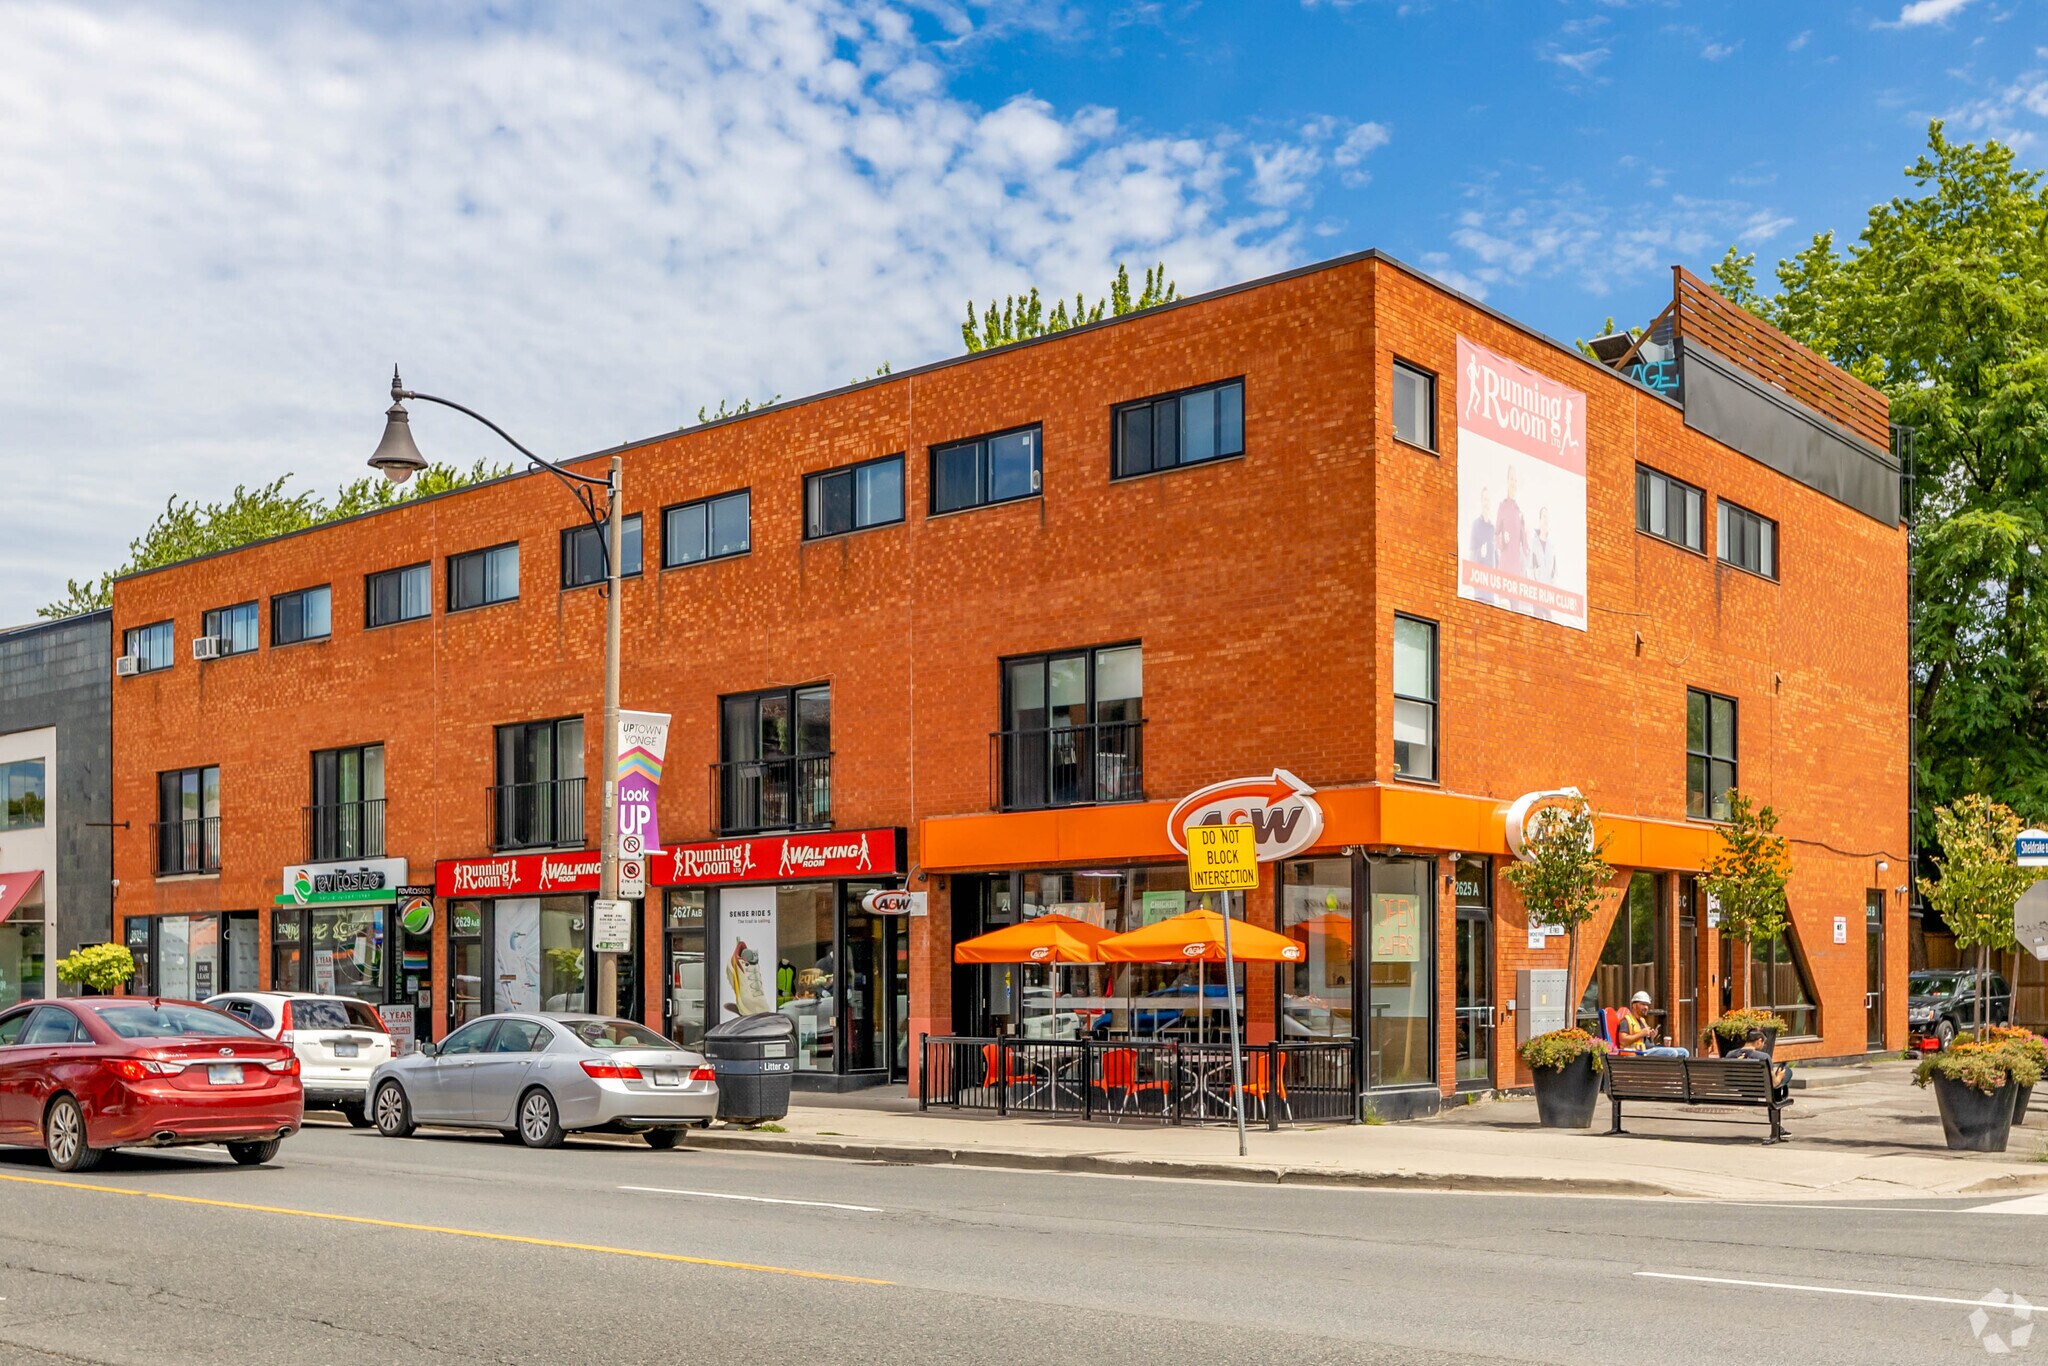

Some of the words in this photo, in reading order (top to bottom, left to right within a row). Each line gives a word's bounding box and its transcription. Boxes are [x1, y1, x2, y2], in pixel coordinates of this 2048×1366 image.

[1482, 364, 1562, 438] Running
[1470, 568, 1489, 586] JOIN
[1490, 574, 1501, 590] US
[1502, 578, 1518, 594] FOR
[1519, 582, 1538, 600] FREE
[1539, 589, 1555, 606] RUN
[1555, 593, 1577, 611] CLUB!
[623, 723, 662, 736] UPTOWN
[625, 735, 657, 747] YONGE
[621, 786, 650, 802] Look
[620, 804, 651, 835] UP
[1202, 830, 1216, 845] DO
[1221, 829, 1240, 844] NOT
[684, 844, 742, 877] Running
[790, 844, 859, 865] WALKING
[1207, 850, 1239, 865] BLOCK
[548, 862, 601, 880] WALKING
[802, 859, 825, 868] ROOM
[315, 867, 386, 893] revitasize
[462, 861, 509, 889] Running
[1194, 869, 1254, 886] INTERSECTION
[397, 886, 431, 895] revitasize
[1455, 882, 1472, 896] 2625
[1473, 882, 1479, 896] A
[672, 905, 691, 918] 2627
[878, 898, 911, 910] A&W
[729, 910, 749, 918] SENSE
[750, 909, 766, 917] RIDE
[455, 917, 471, 928] 2629
[389, 1011, 412, 1019] YEAR
[764, 1062, 782, 1071] Litter
